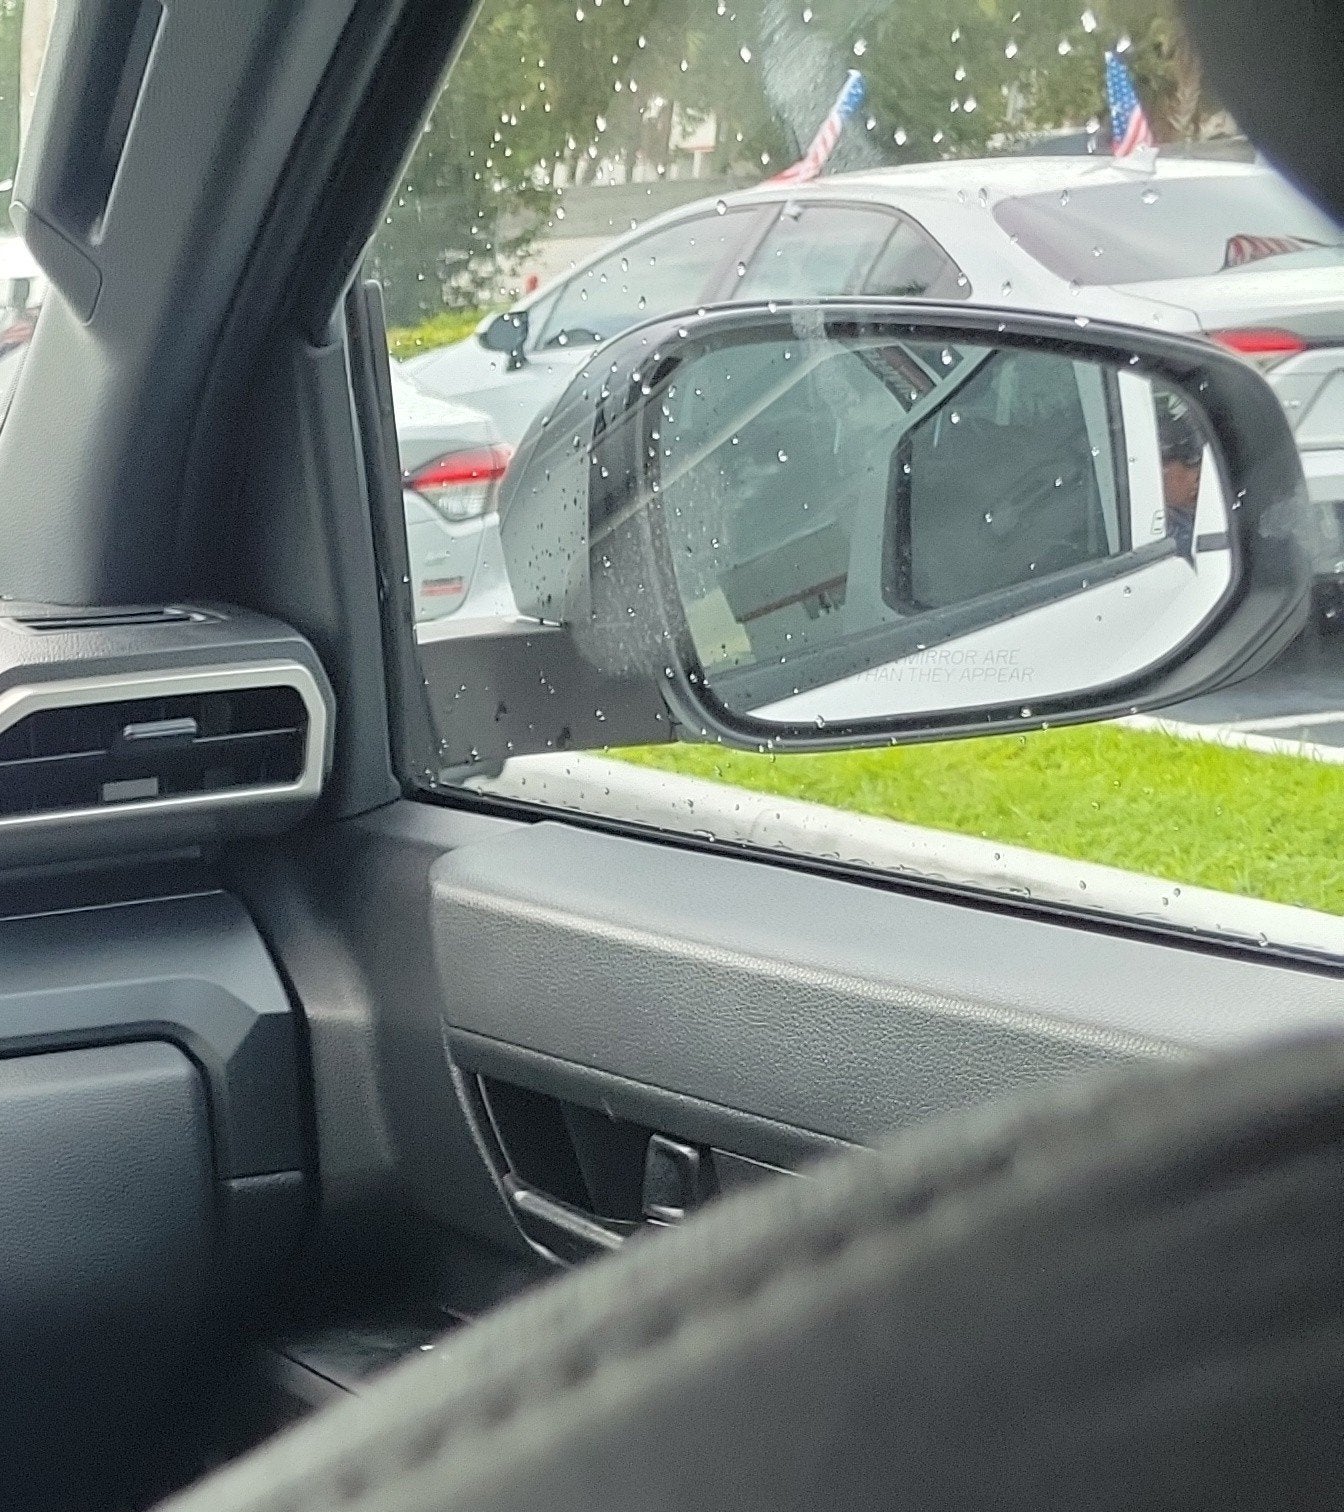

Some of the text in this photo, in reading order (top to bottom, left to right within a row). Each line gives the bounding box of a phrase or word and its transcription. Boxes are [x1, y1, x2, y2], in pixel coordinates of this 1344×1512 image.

[982, 649, 1021, 665] ARE
[910, 667, 953, 682] THEY
[959, 667, 1034, 682] APPEAR
